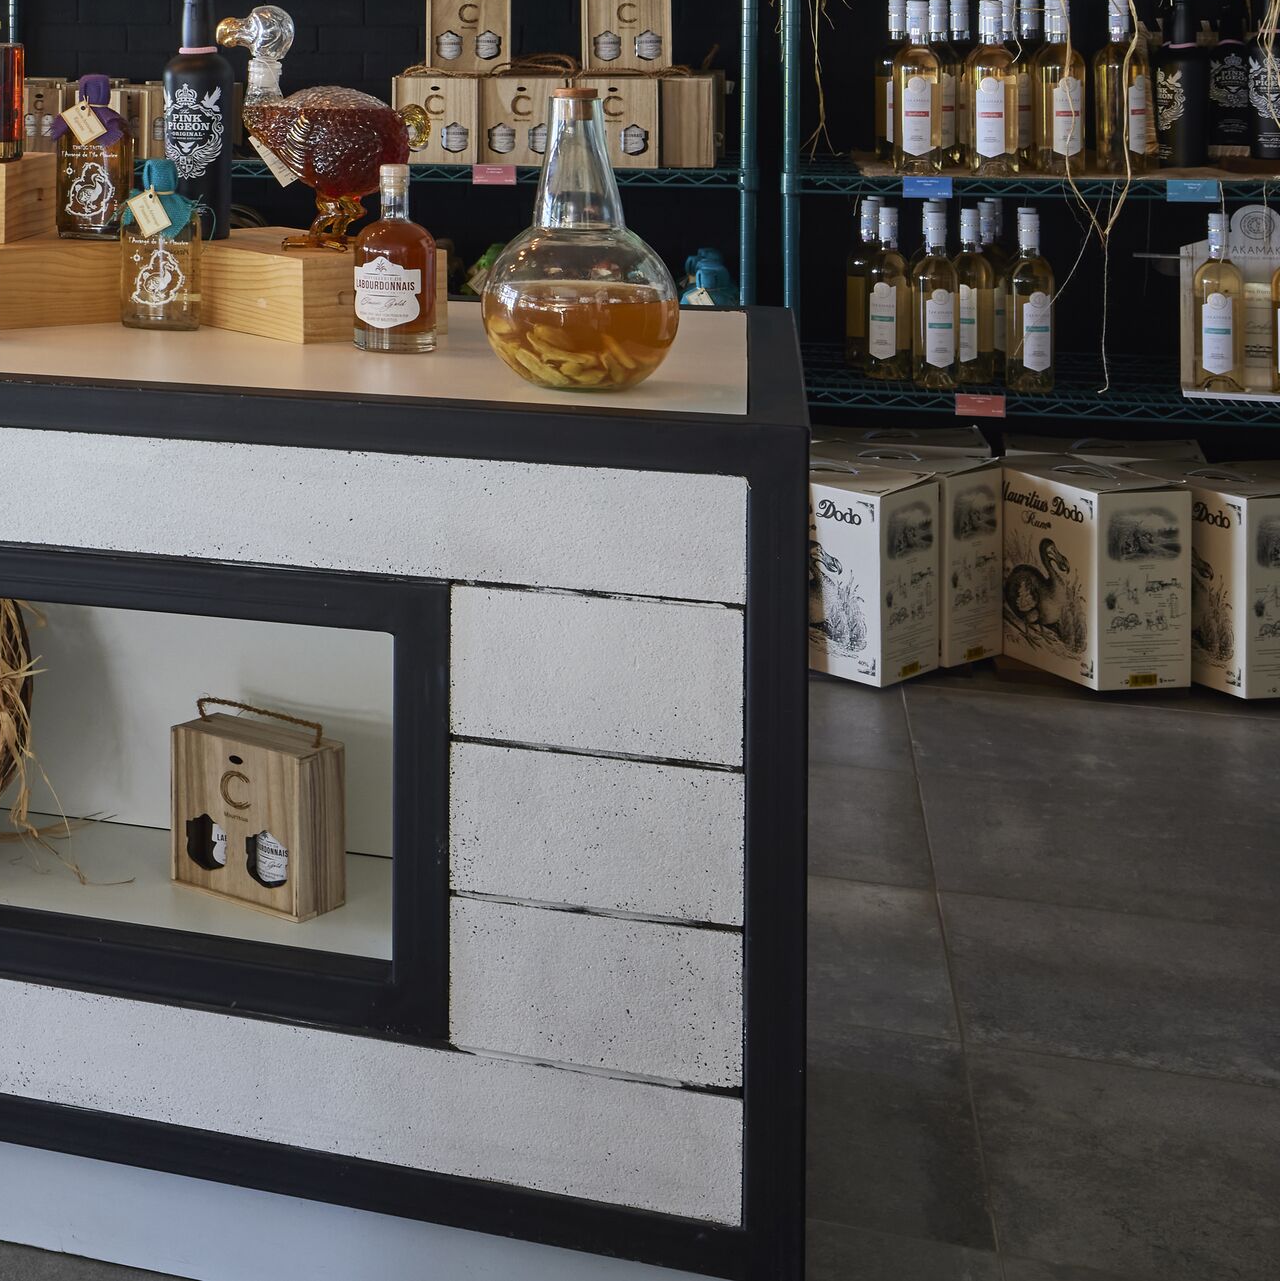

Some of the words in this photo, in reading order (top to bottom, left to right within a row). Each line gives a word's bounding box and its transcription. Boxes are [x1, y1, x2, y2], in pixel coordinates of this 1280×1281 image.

[167, 121, 211, 131] PIGEON
[172, 113, 203, 123] PINK
[356, 279, 415, 291] LABOURDONNAIS
[815, 498, 862, 526] Dodo
[1050, 495, 1085, 523] Dodo
[1192, 501, 1231, 529] Dodo
[220, 770, 252, 811] C
